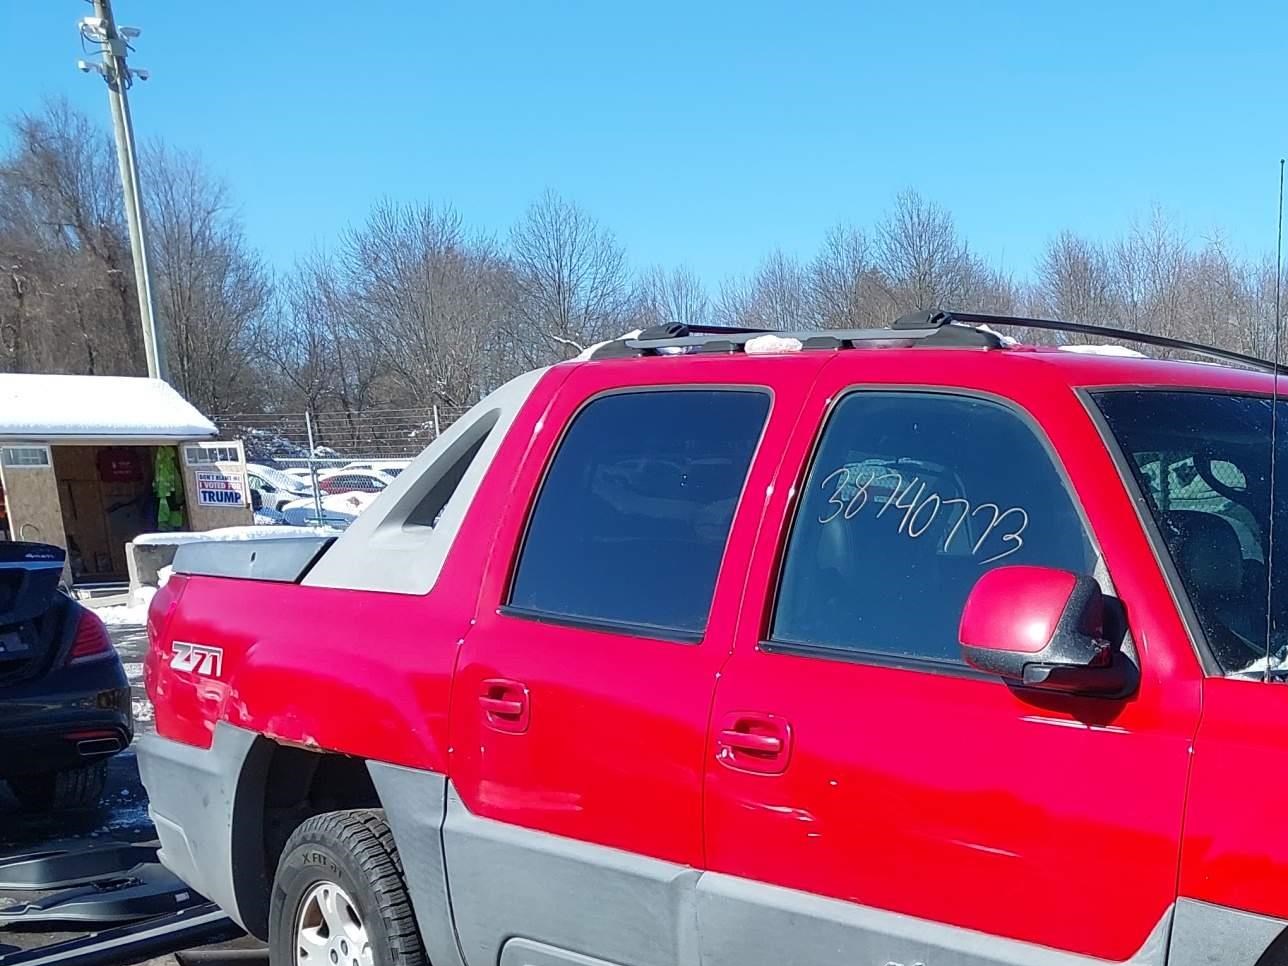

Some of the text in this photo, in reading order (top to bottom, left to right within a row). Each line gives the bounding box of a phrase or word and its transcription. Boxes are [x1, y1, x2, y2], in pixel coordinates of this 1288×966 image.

[201, 490, 242, 503] TRUMP
[203, 481, 226, 489] VOTED
[818, 468, 1029, 565] 38740773
[170, 640, 223, 677] Z71
